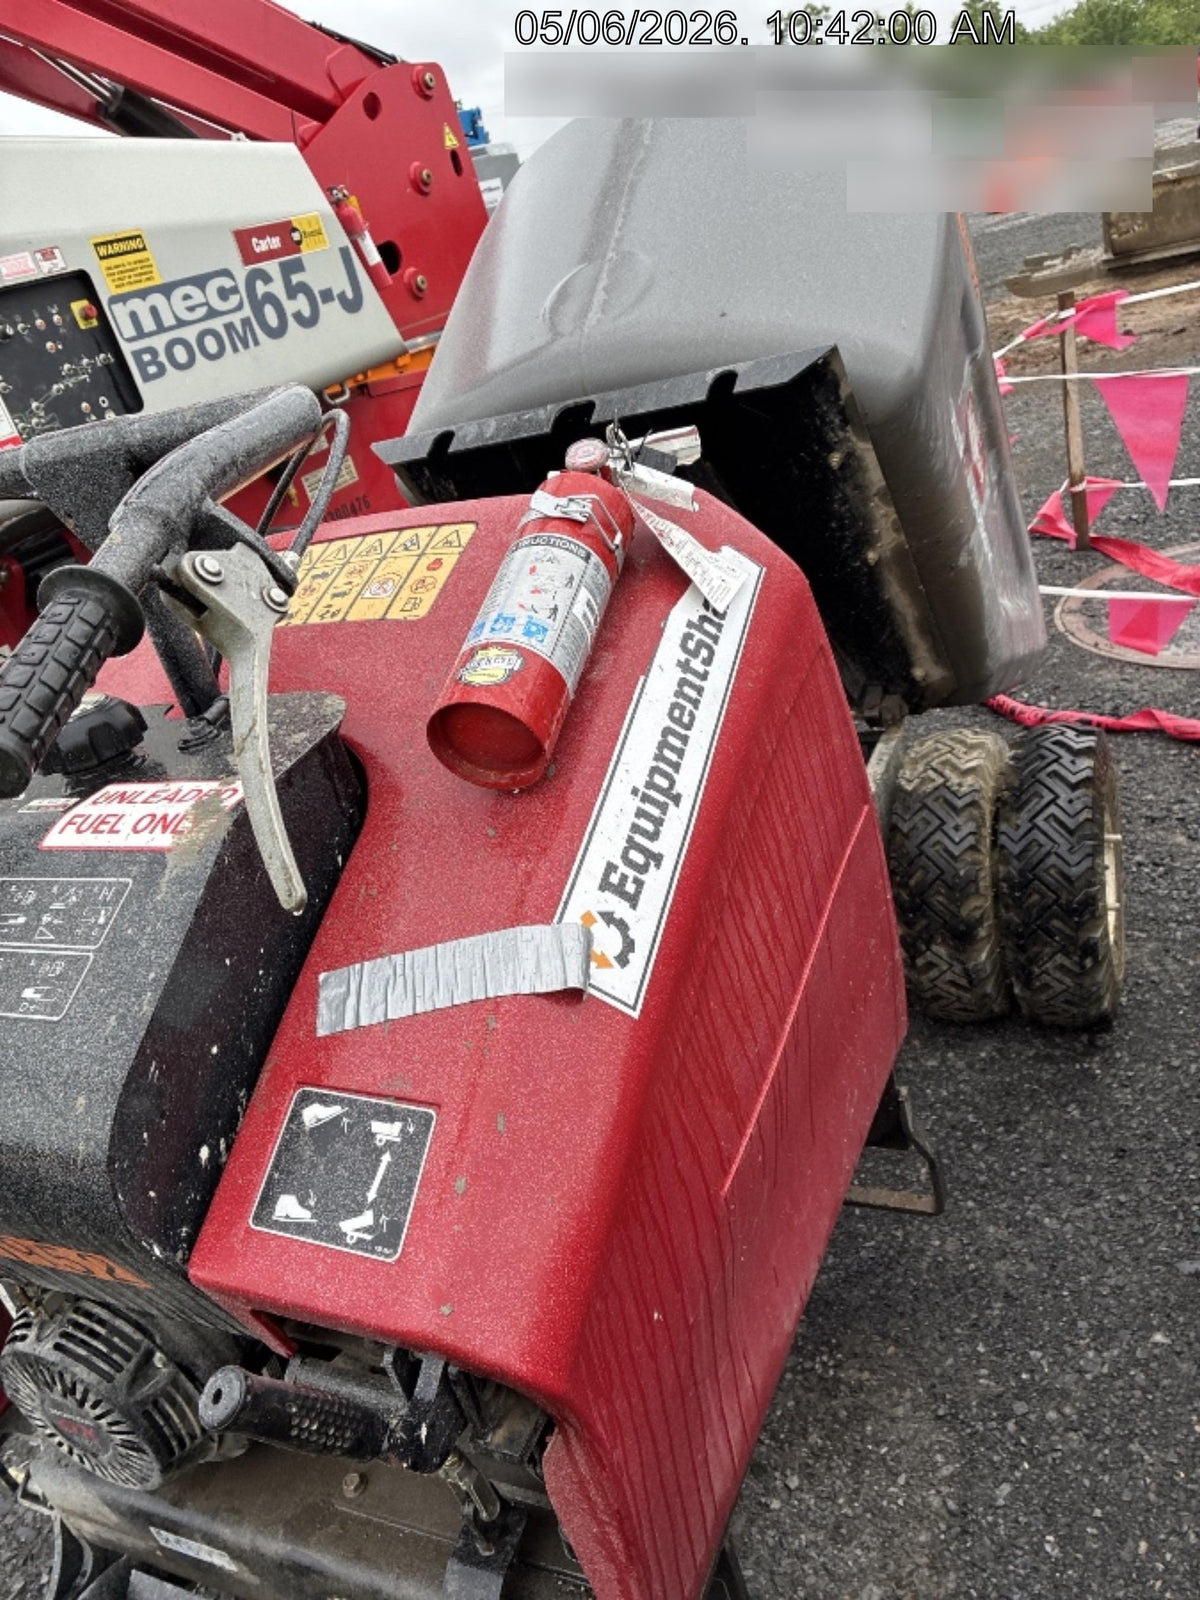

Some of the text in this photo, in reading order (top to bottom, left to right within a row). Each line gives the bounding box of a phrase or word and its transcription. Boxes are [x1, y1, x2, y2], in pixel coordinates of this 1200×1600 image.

[97, 237, 145, 257] WARNING
[109, 276, 241, 340] mec
[245, 246, 364, 340] 65-J
[131, 318, 260, 383] BOOM
[58, 813, 196, 835] FUEL ONL
